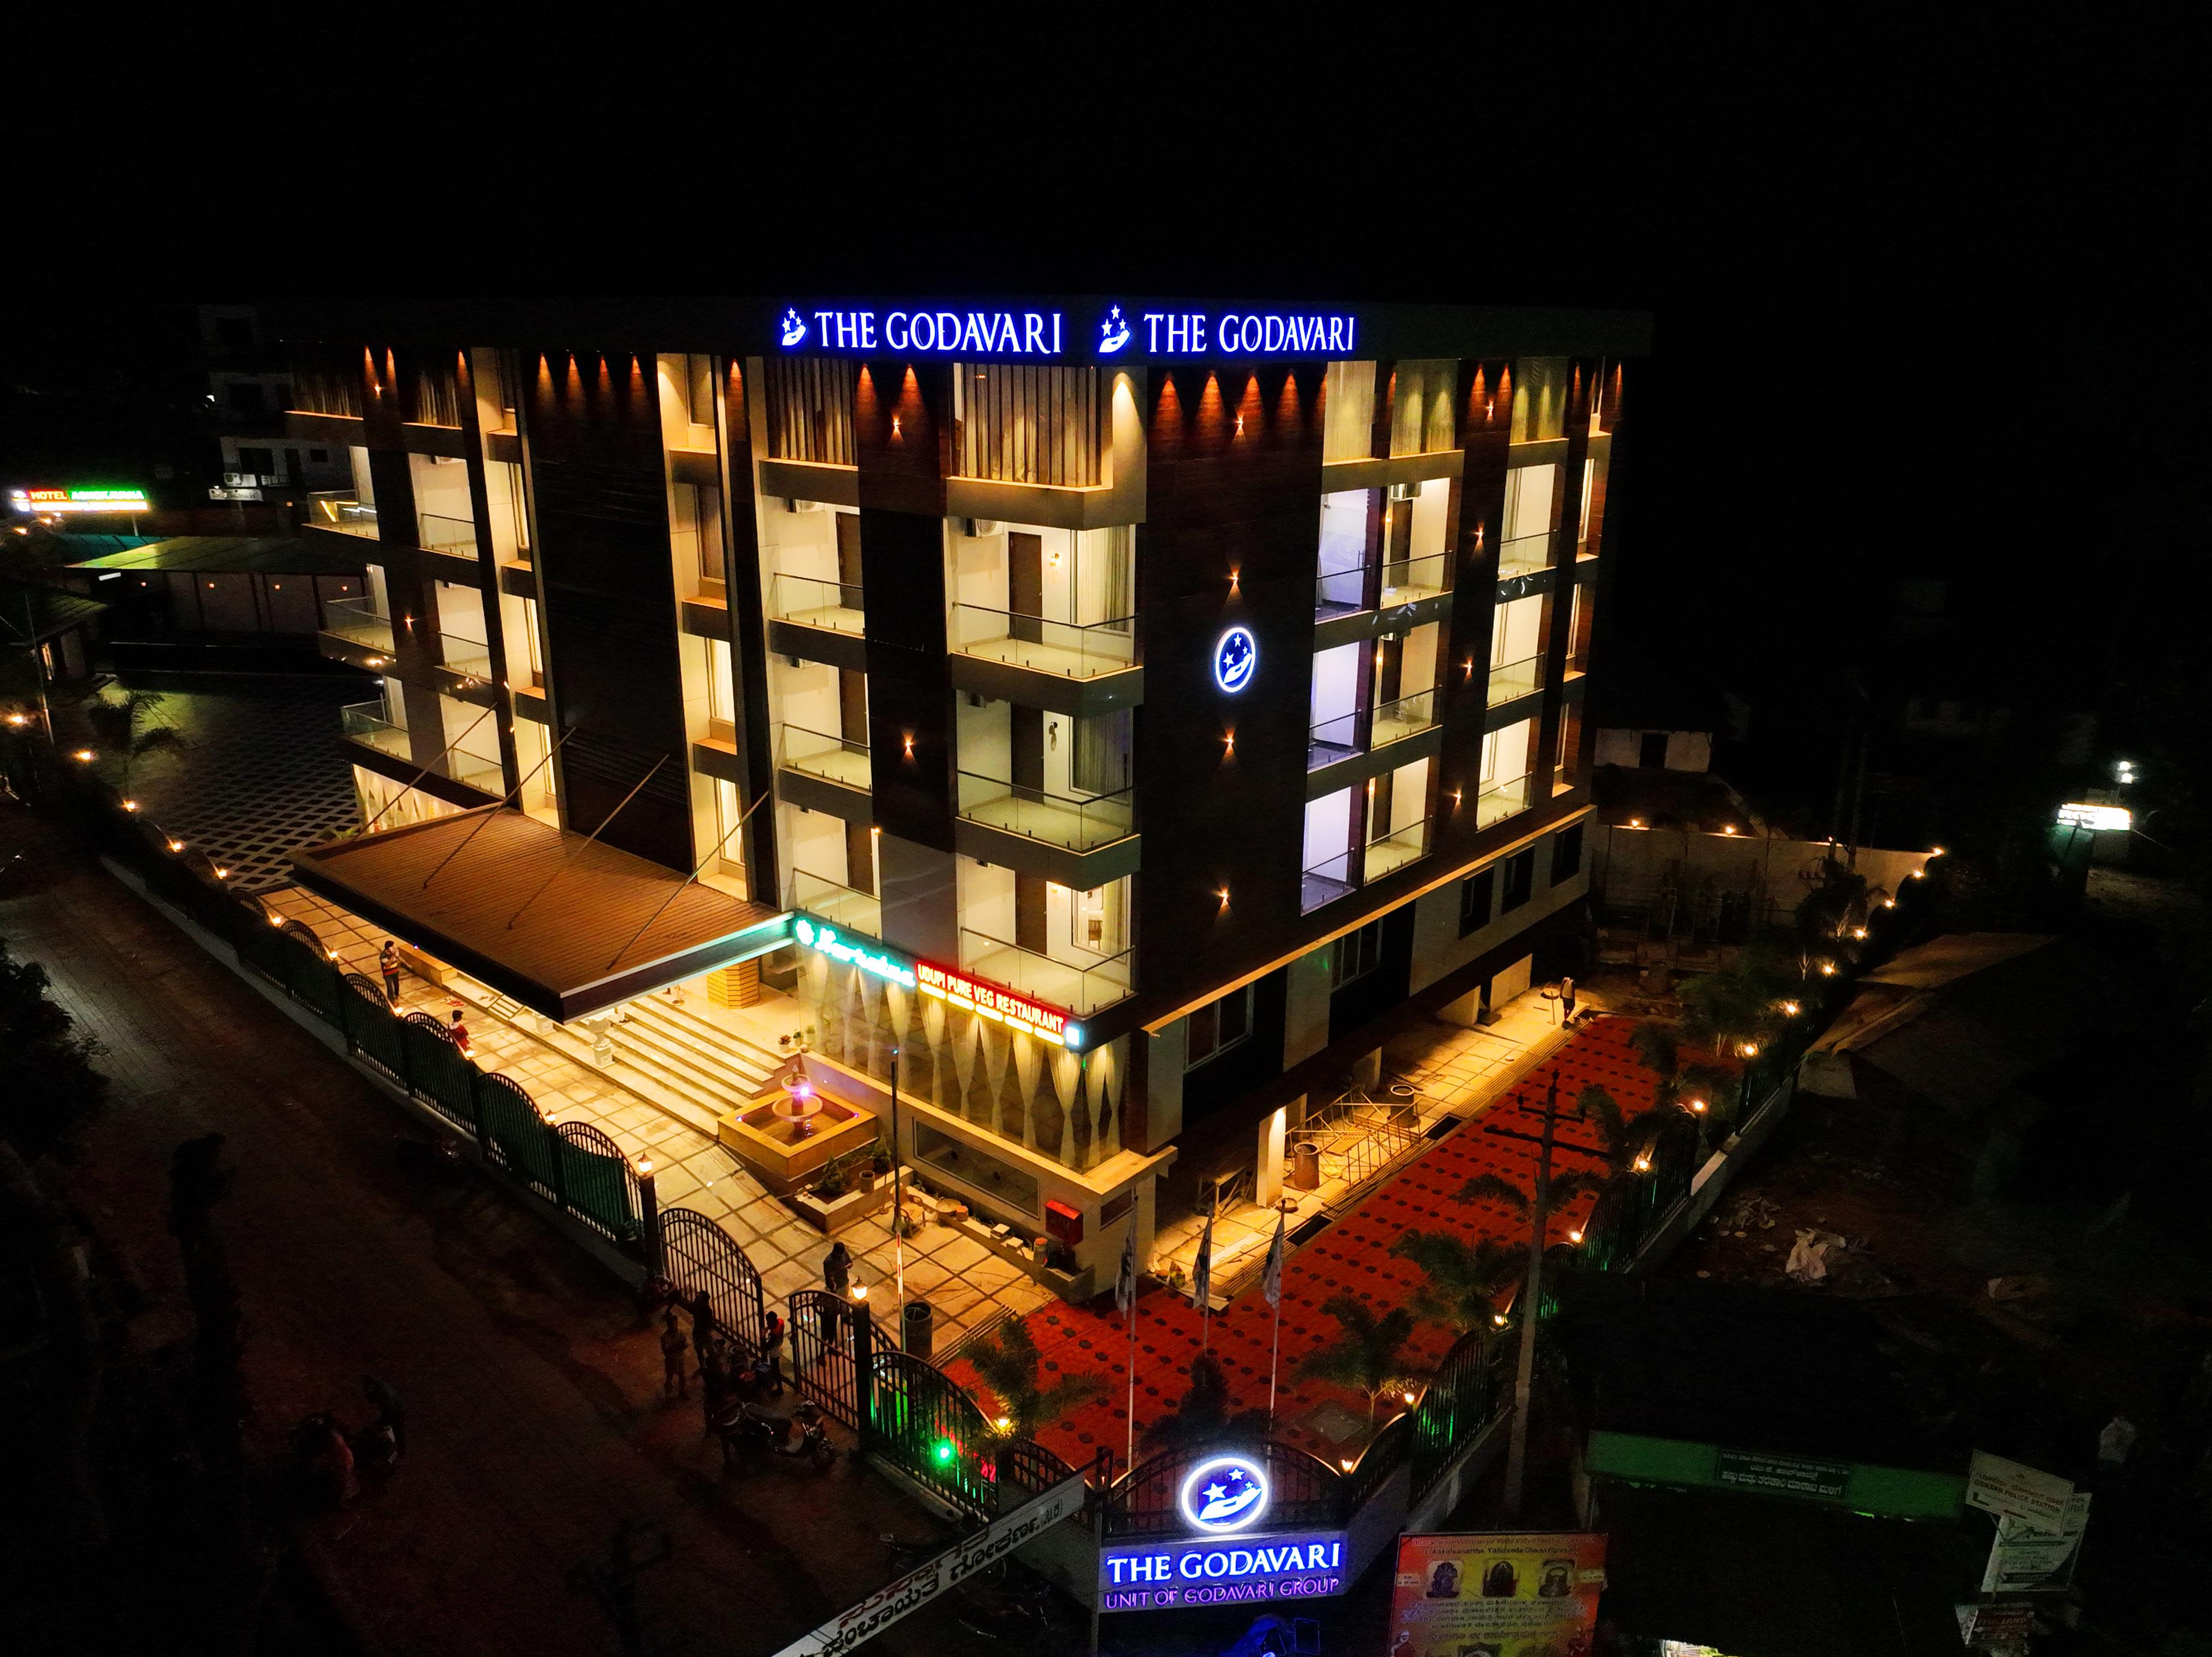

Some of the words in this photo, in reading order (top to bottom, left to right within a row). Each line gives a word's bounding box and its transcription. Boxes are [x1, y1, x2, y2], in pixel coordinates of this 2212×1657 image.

[815, 311, 877, 348] THE
[886, 312, 1061, 354] GODAVARI
[1144, 314, 1207, 352] THE
[1219, 315, 1355, 352] GODAVARI
[30, 491, 68, 501] HOTEL
[917, 963, 946, 989] UDUPI
[947, 975, 973, 999] PURE
[973, 984, 995, 1007] VEG
[996, 993, 1064, 1033] RESTAURANT
[1107, 1556, 1172, 1583] THE
[1180, 1543, 1341, 1579] GODAVARI
[1106, 1592, 1150, 1609] UNIT
[1154, 1589, 1178, 1605] OF
[1184, 1583, 1274, 1604] GODAVARI
[1280, 1576, 1339, 1597] GROUP
